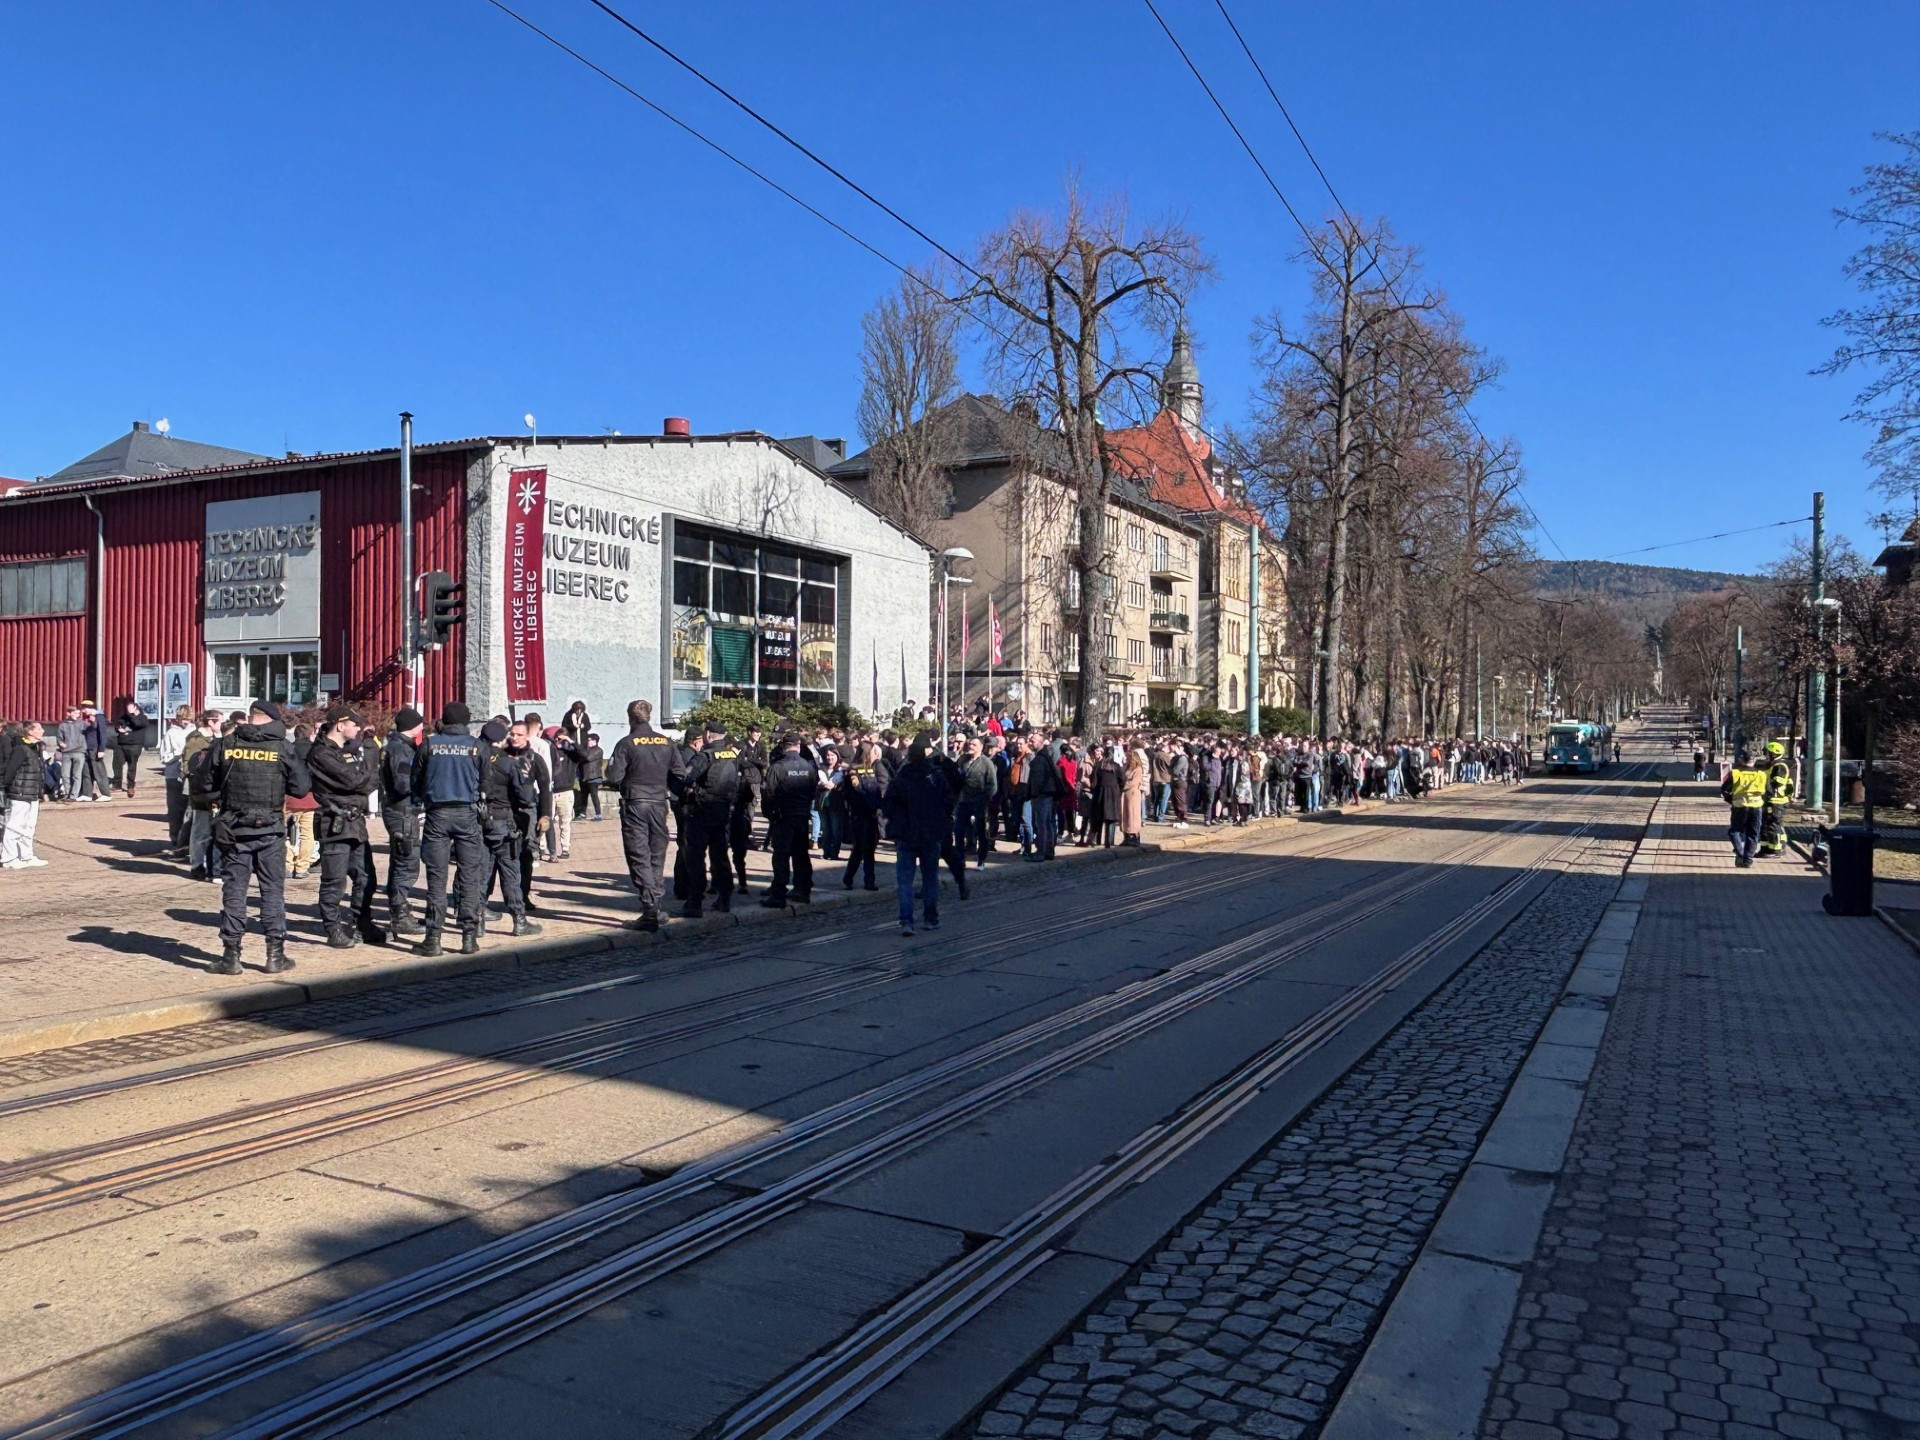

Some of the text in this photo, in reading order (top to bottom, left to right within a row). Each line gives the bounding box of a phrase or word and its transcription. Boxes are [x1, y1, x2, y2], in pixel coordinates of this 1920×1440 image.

[545, 498, 660, 545] ECHNICKÉ
[206, 553, 285, 583] MUZEUM
[206, 583, 287, 610] LIBEREC
[542, 568, 630, 603] IBEREC
[511, 522, 527, 691] TECHNICKÉ MUZEUM
[527, 570, 538, 642] LIBEREC
[171, 673, 182, 689] A
[224, 748, 279, 762] POLICIE
